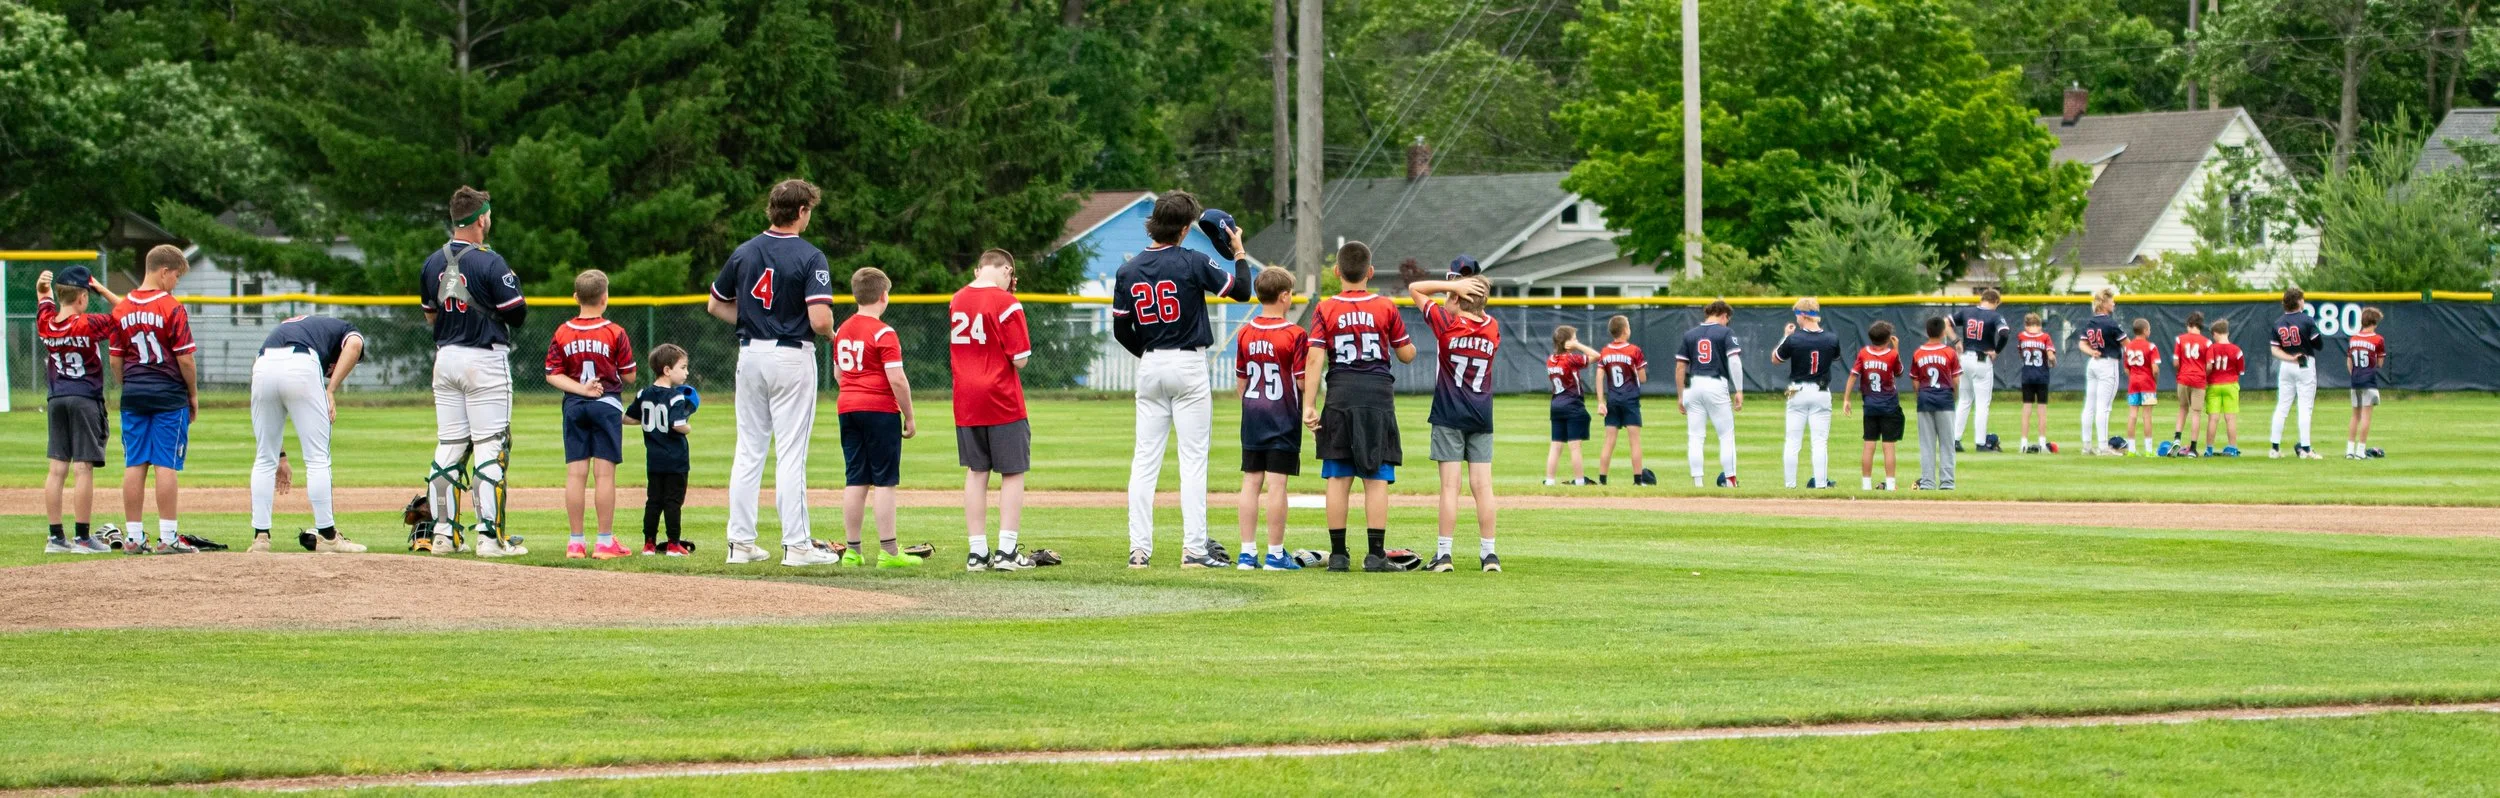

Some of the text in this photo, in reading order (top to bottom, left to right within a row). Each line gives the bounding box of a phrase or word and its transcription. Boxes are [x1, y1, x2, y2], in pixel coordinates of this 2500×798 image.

[751, 268, 775, 310] 4
[1131, 280, 1181, 325] 26
[951, 311, 987, 345] 24
[1338, 312, 1375, 329] SILVA
[1966, 318, 1984, 341] 21
[131, 331, 163, 364] 11
[2086, 328, 2105, 348] 24
[2277, 325, 2302, 347] 20
[837, 339, 865, 371] 67
[1249, 340, 1275, 357] BAYS
[1334, 332, 1382, 364] 55
[1697, 339, 1712, 364] 9
[2023, 350, 2043, 367] 23
[2127, 349, 2145, 367] 23
[2185, 342, 2200, 359] 14
[2351, 350, 2370, 368] 15
[51, 352, 86, 378] 13
[1450, 354, 1489, 392] 77
[1810, 350, 1819, 375] 1
[1863, 360, 1888, 372] SMITH
[2215, 355, 2228, 371] 11
[1244, 361, 1283, 400] 25
[1611, 365, 1624, 388] 6
[1868, 372, 1881, 392] 3
[1927, 367, 1941, 389] 2
[641, 401, 669, 433] 00
